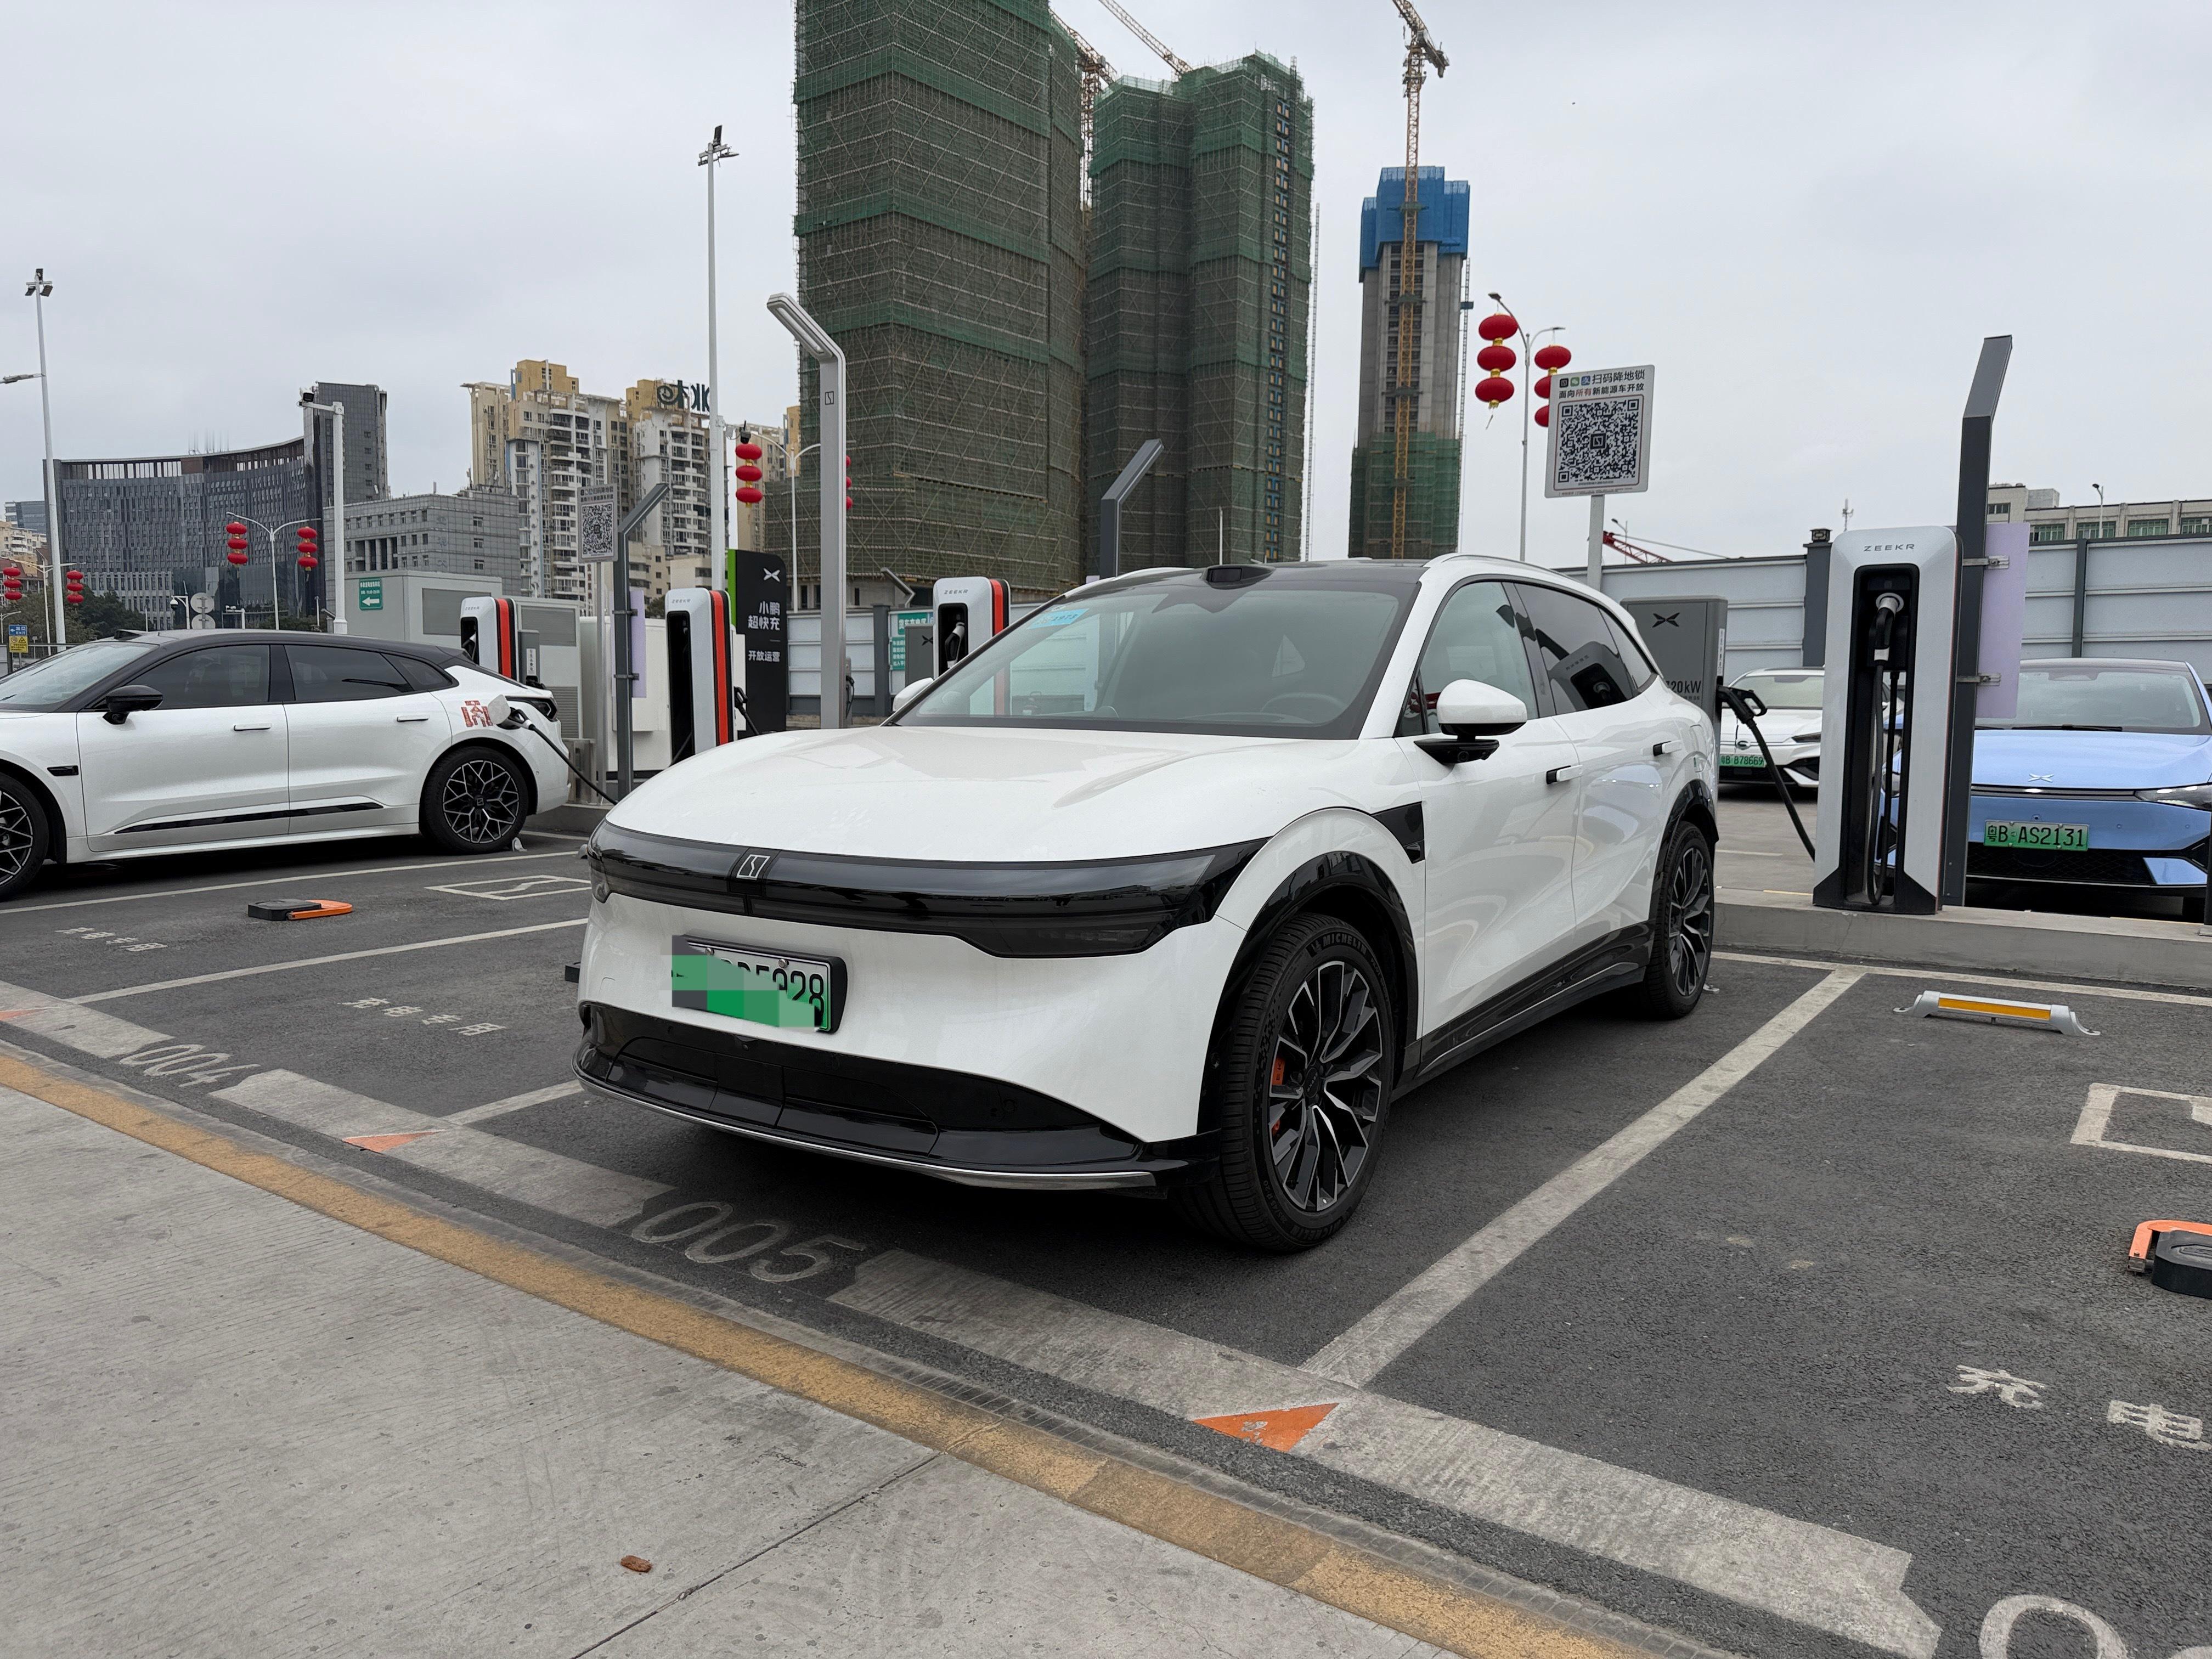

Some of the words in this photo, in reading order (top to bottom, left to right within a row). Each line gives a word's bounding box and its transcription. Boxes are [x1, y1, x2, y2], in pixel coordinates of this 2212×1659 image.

[1592, 369, 1645, 384] 扫码降地锁
[1559, 383, 1644, 399] 面向所有新能源车开放
[1864, 544, 1915, 552] ZEEKR
[759, 601, 780, 616] 小鹏
[748, 615, 780, 631] 超快充
[748, 650, 780, 662] 开放运营
[1987, 825, 2008, 843] 粤B
[2018, 826, 2084, 847] AS2131
[1322, 933, 1367, 955] MICHELIN
[119, 1044, 261, 1087] 004
[632, 1201, 866, 1283] 005
